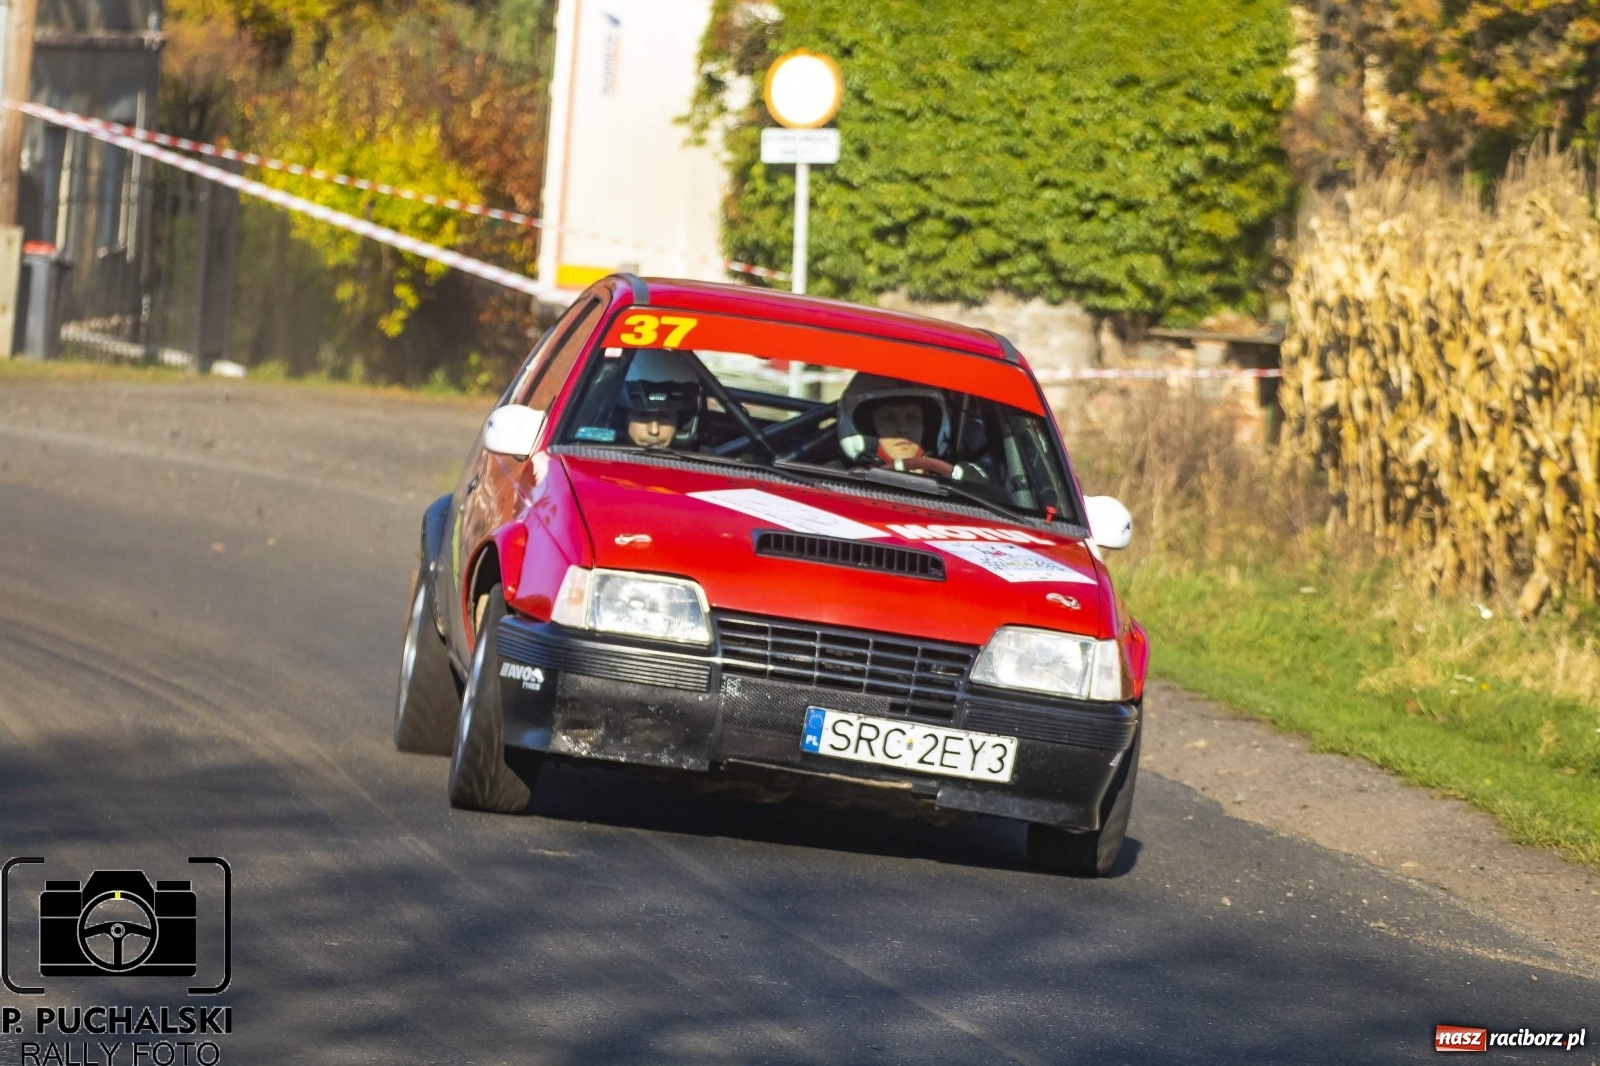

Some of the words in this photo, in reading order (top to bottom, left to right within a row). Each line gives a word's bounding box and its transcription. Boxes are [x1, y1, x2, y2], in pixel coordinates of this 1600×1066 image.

[620, 314, 699, 348] 37
[886, 524, 1057, 546] MOTUL
[805, 734, 819, 747] PL
[828, 718, 908, 761] SRC
[916, 732, 1009, 775] 2EY3
